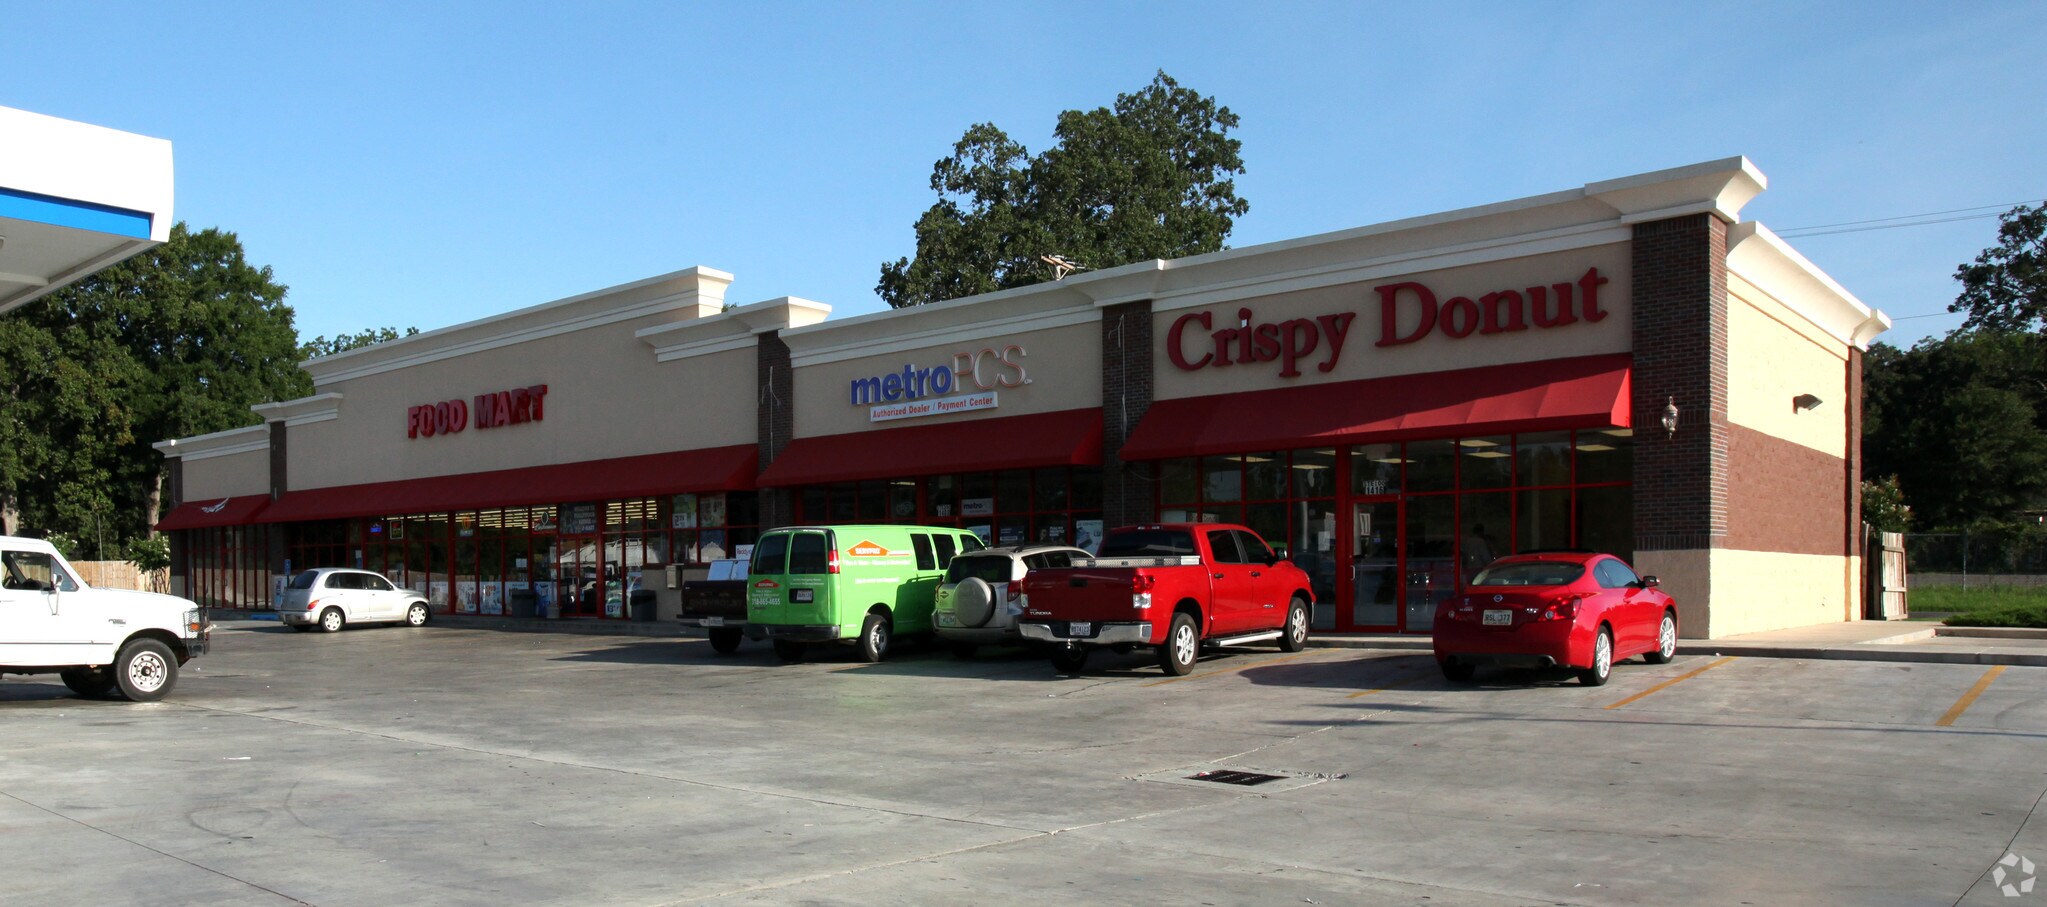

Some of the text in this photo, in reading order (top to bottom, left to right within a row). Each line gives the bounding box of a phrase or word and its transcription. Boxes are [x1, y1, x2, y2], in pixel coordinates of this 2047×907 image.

[1167, 267, 1609, 377] Crispy Donut
[408, 384, 547, 438] FOOD MART
[873, 405, 907, 418] Authorized
[909, 403, 930, 415] Dealer
[938, 400, 966, 411] Payment
[969, 396, 993, 406] Center
